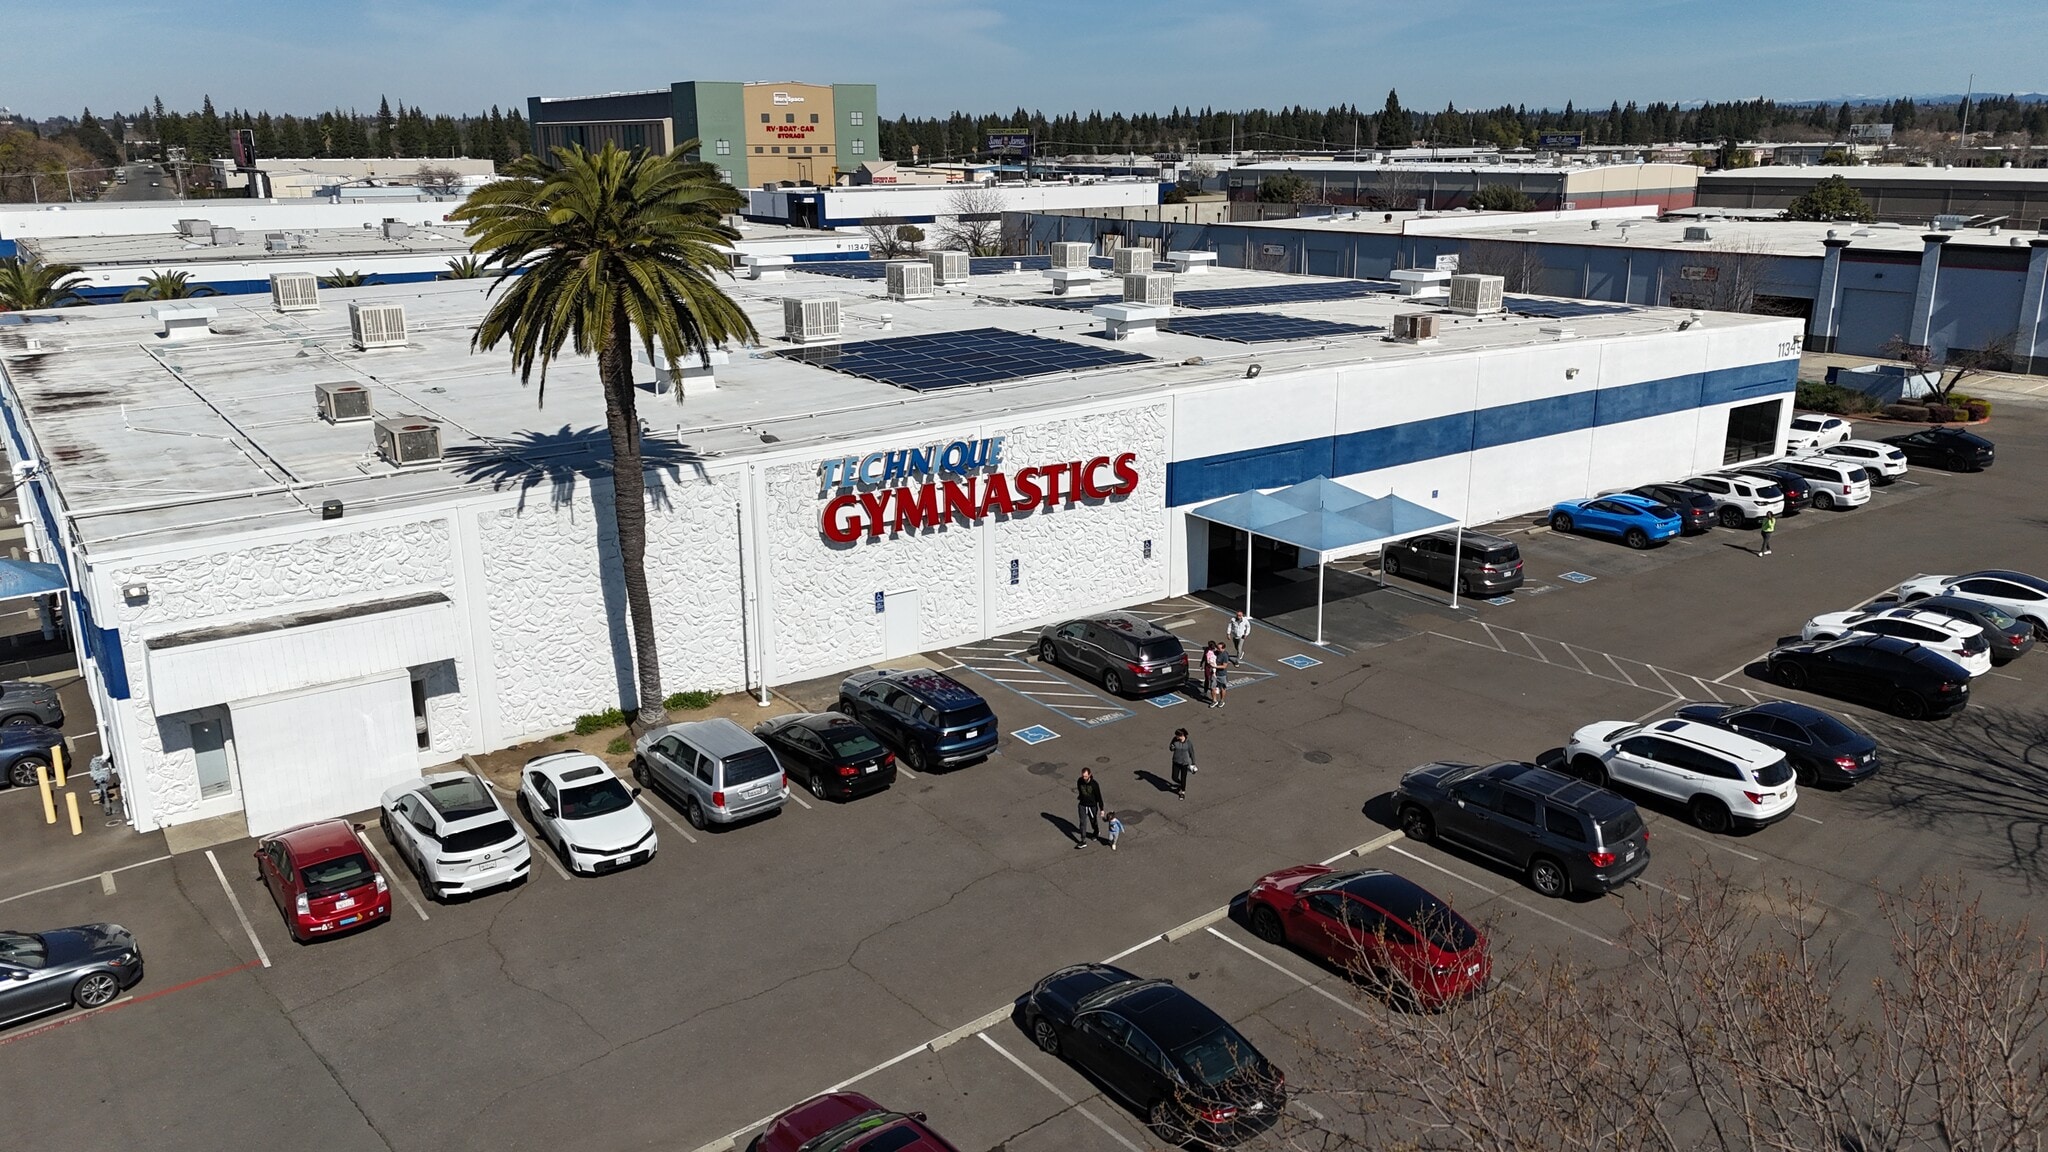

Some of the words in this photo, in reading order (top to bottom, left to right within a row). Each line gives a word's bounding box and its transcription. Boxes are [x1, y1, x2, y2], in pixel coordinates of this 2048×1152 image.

[848, 243, 869, 251] 11347
[820, 436, 1006, 492] TECHNIQUE
[821, 452, 1139, 543] GYMNASTICS
